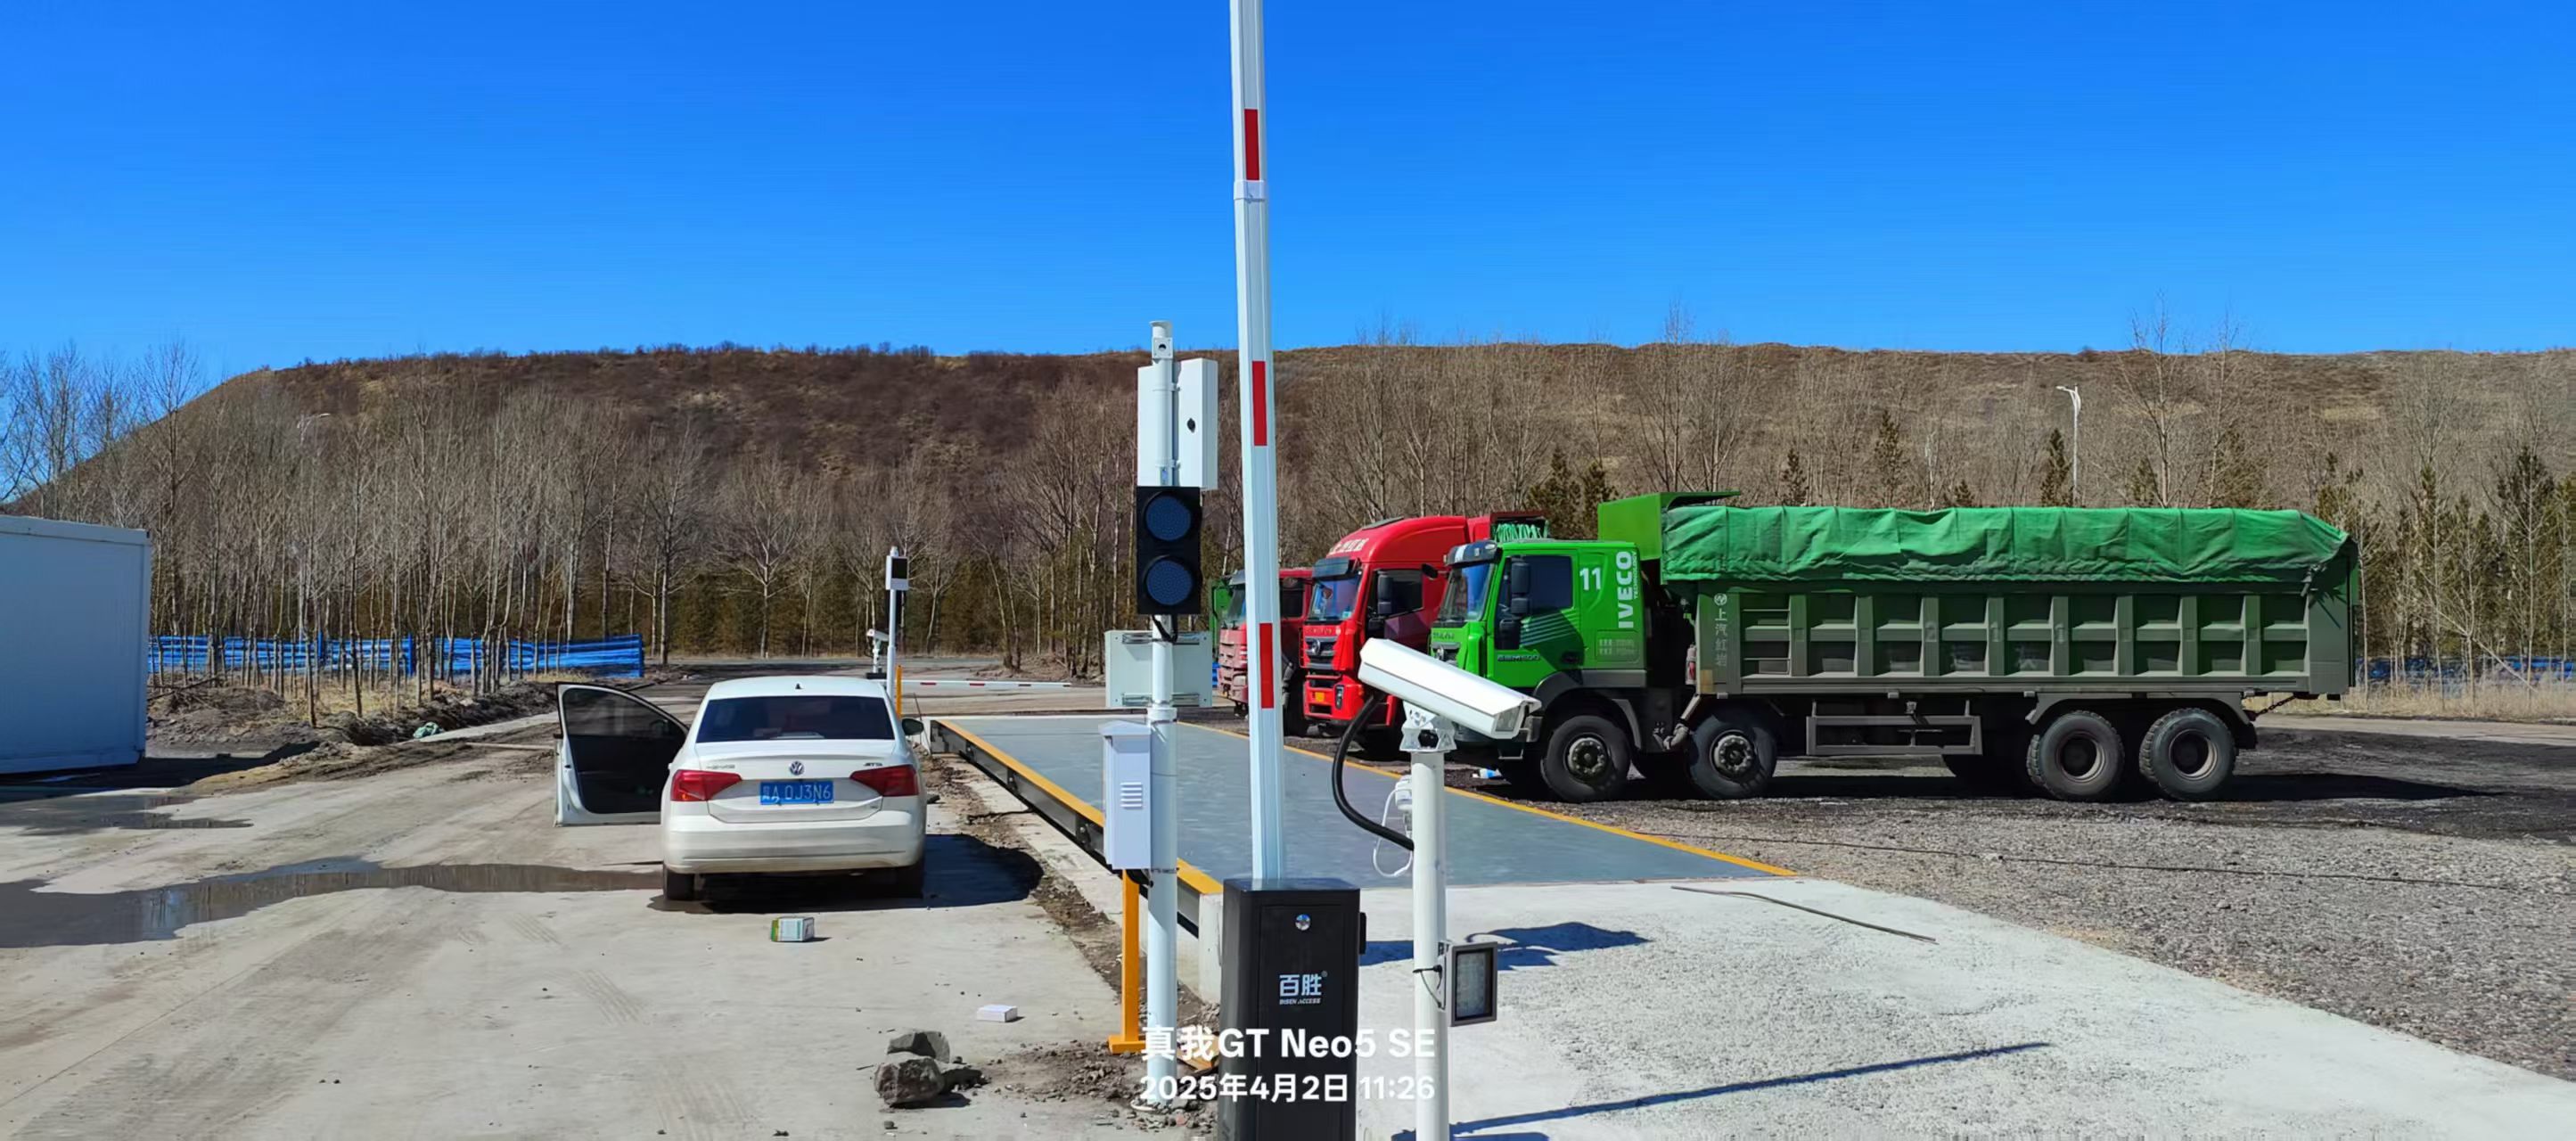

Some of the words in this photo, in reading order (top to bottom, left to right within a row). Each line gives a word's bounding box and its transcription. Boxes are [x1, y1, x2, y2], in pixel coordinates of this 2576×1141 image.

[1579, 567, 1601, 590] 11
[1616, 551, 1634, 628] IVECO
[1279, 973, 1322, 997] 百胜
